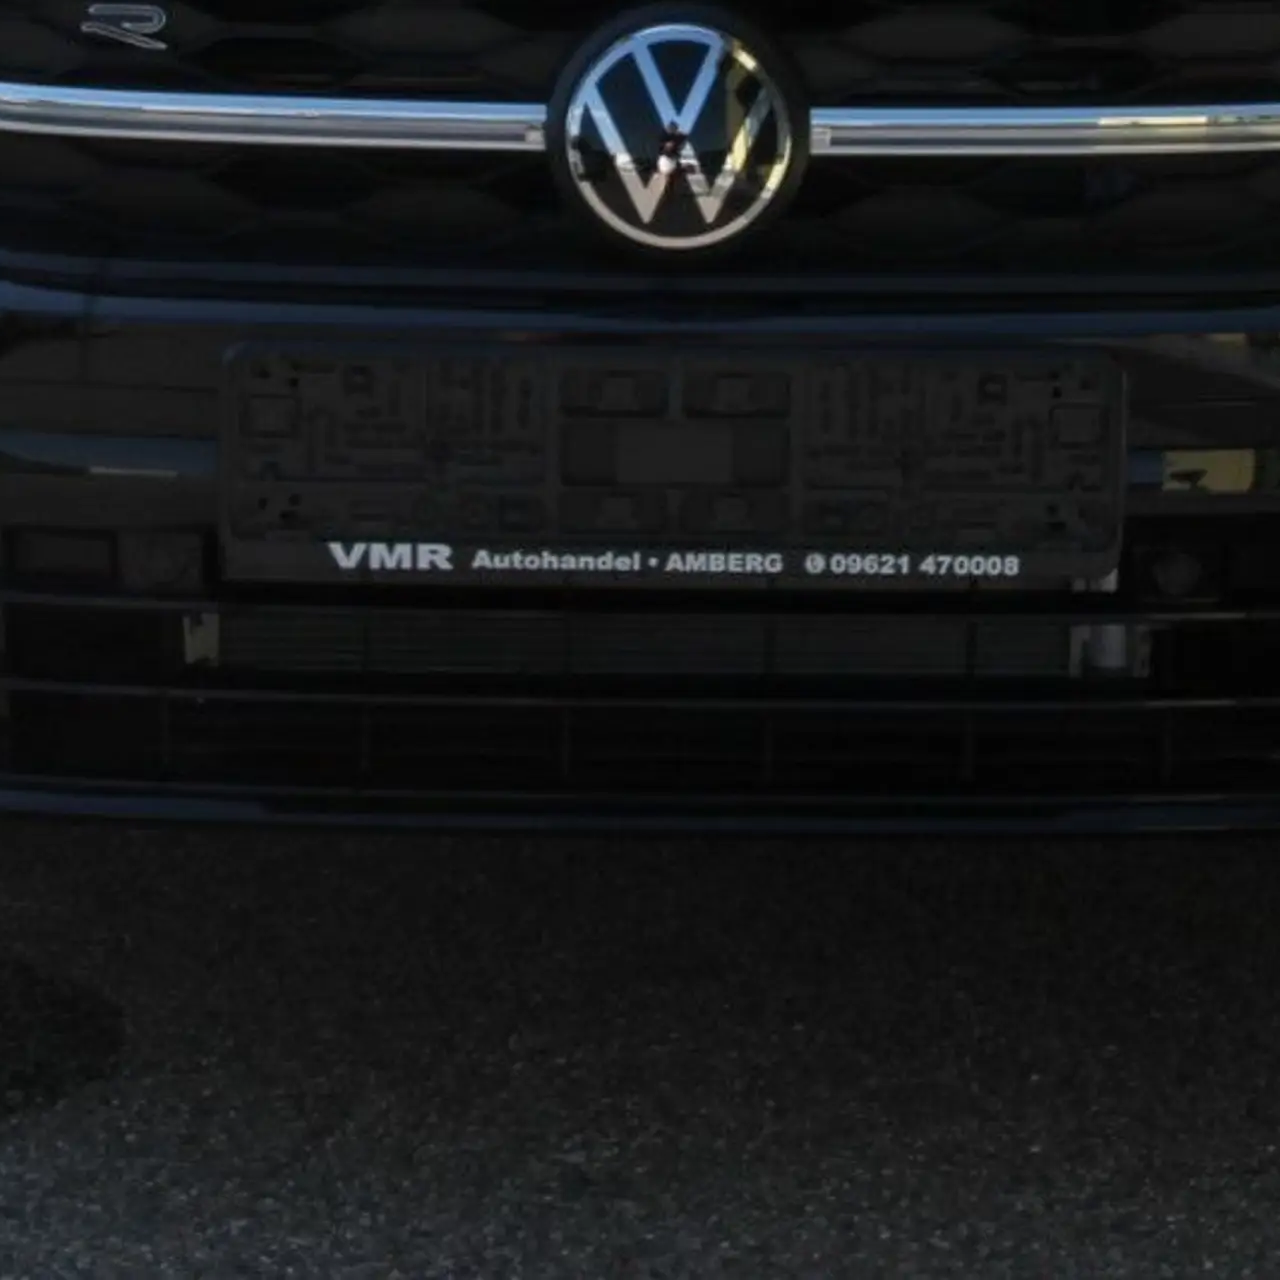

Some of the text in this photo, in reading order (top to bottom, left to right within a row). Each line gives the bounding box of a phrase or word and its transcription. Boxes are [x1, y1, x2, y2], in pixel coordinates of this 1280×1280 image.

[328, 542, 1021, 576] VMR Autohandel AMBERG 09621 470008
